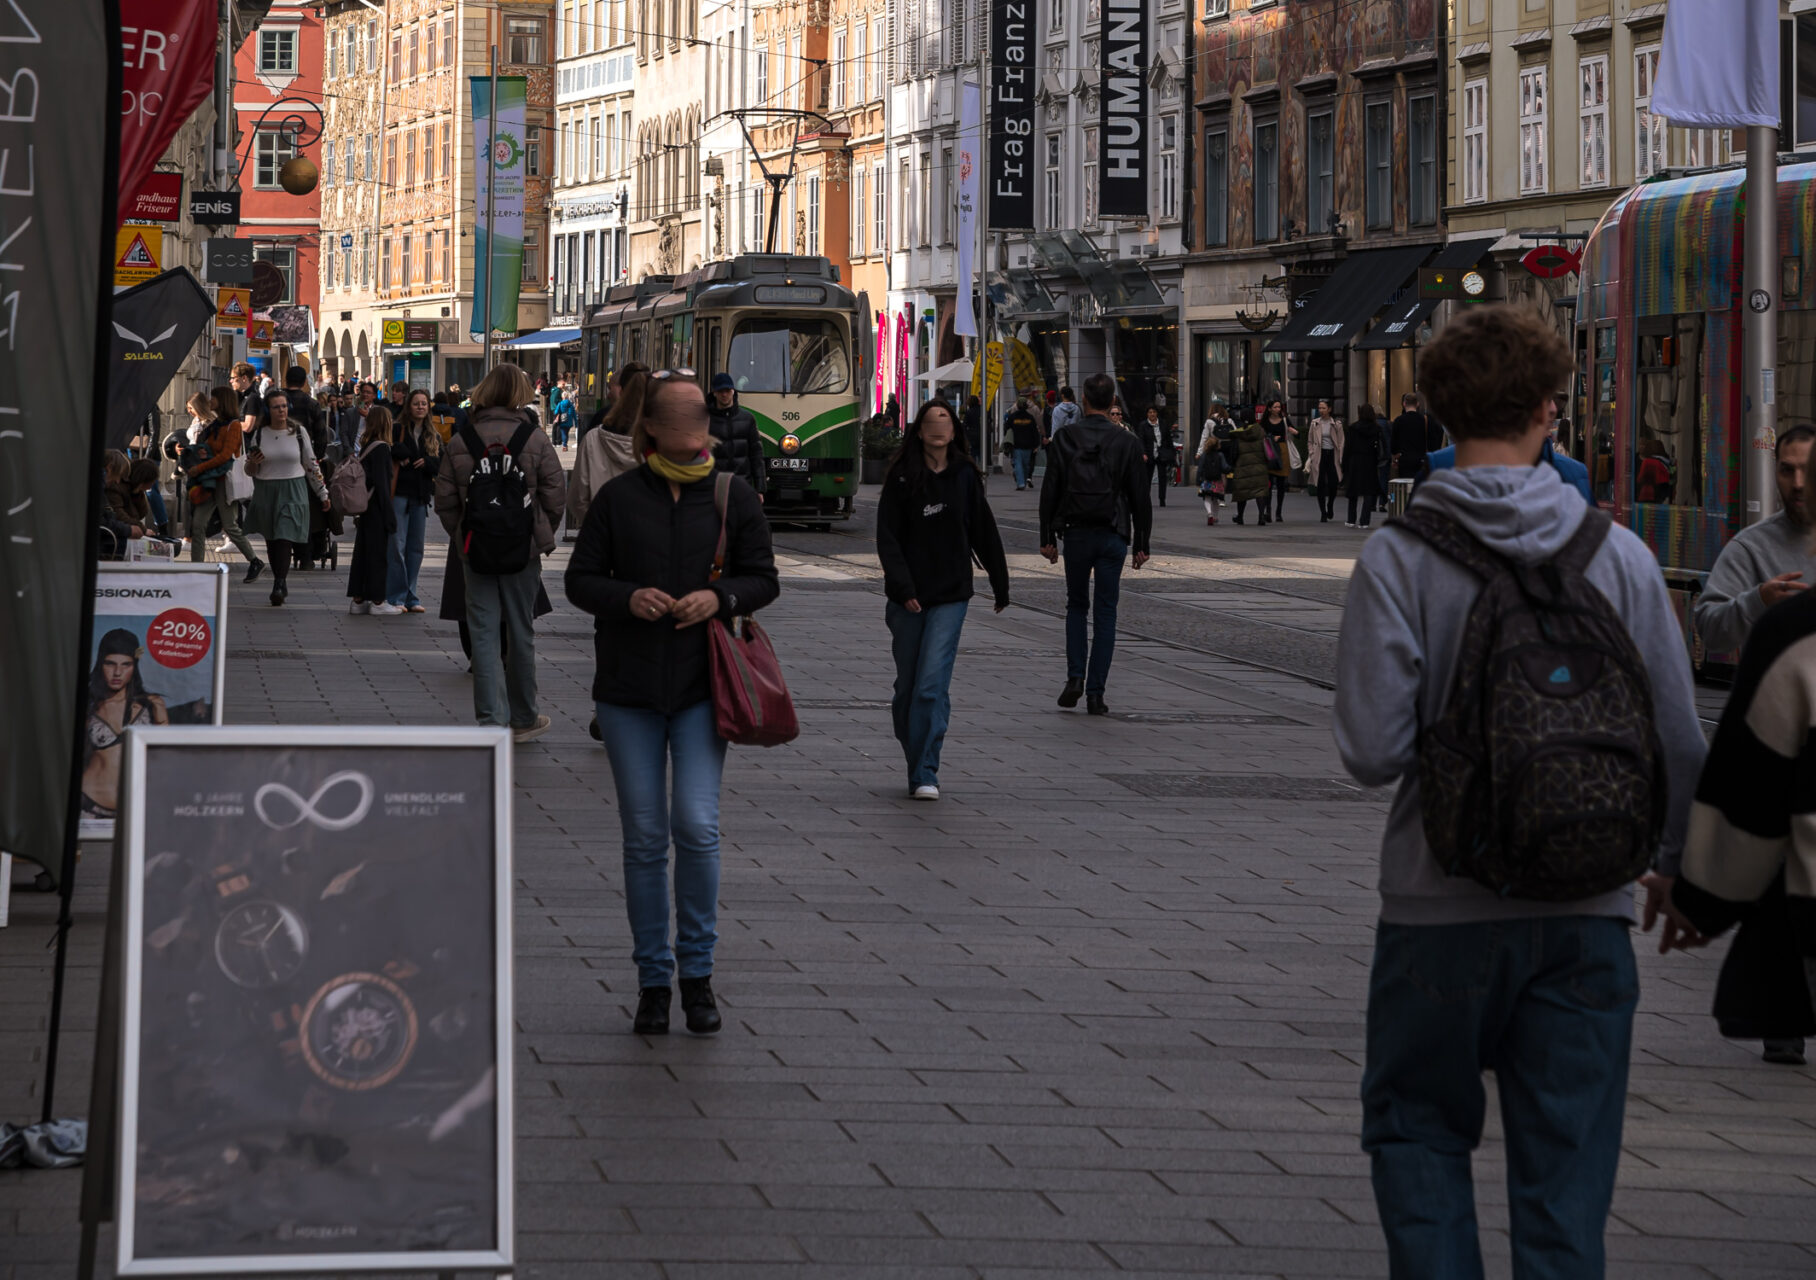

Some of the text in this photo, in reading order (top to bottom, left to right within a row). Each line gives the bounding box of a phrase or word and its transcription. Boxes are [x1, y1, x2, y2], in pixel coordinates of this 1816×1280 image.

[997, 118, 1031, 197] Frag
[135, 202, 173, 214] Friseur
[211, 253, 249, 268] COS
[123, 351, 164, 360] SALEWA
[781, 411, 800, 421] 506
[772, 459, 809, 469] GRAZ
[153, 620, 206, 641] -20%
[384, 792, 466, 804] UNENDLICHE
[173, 805, 245, 817] HOLZKERN
[385, 805, 441, 817] VIELFALT
